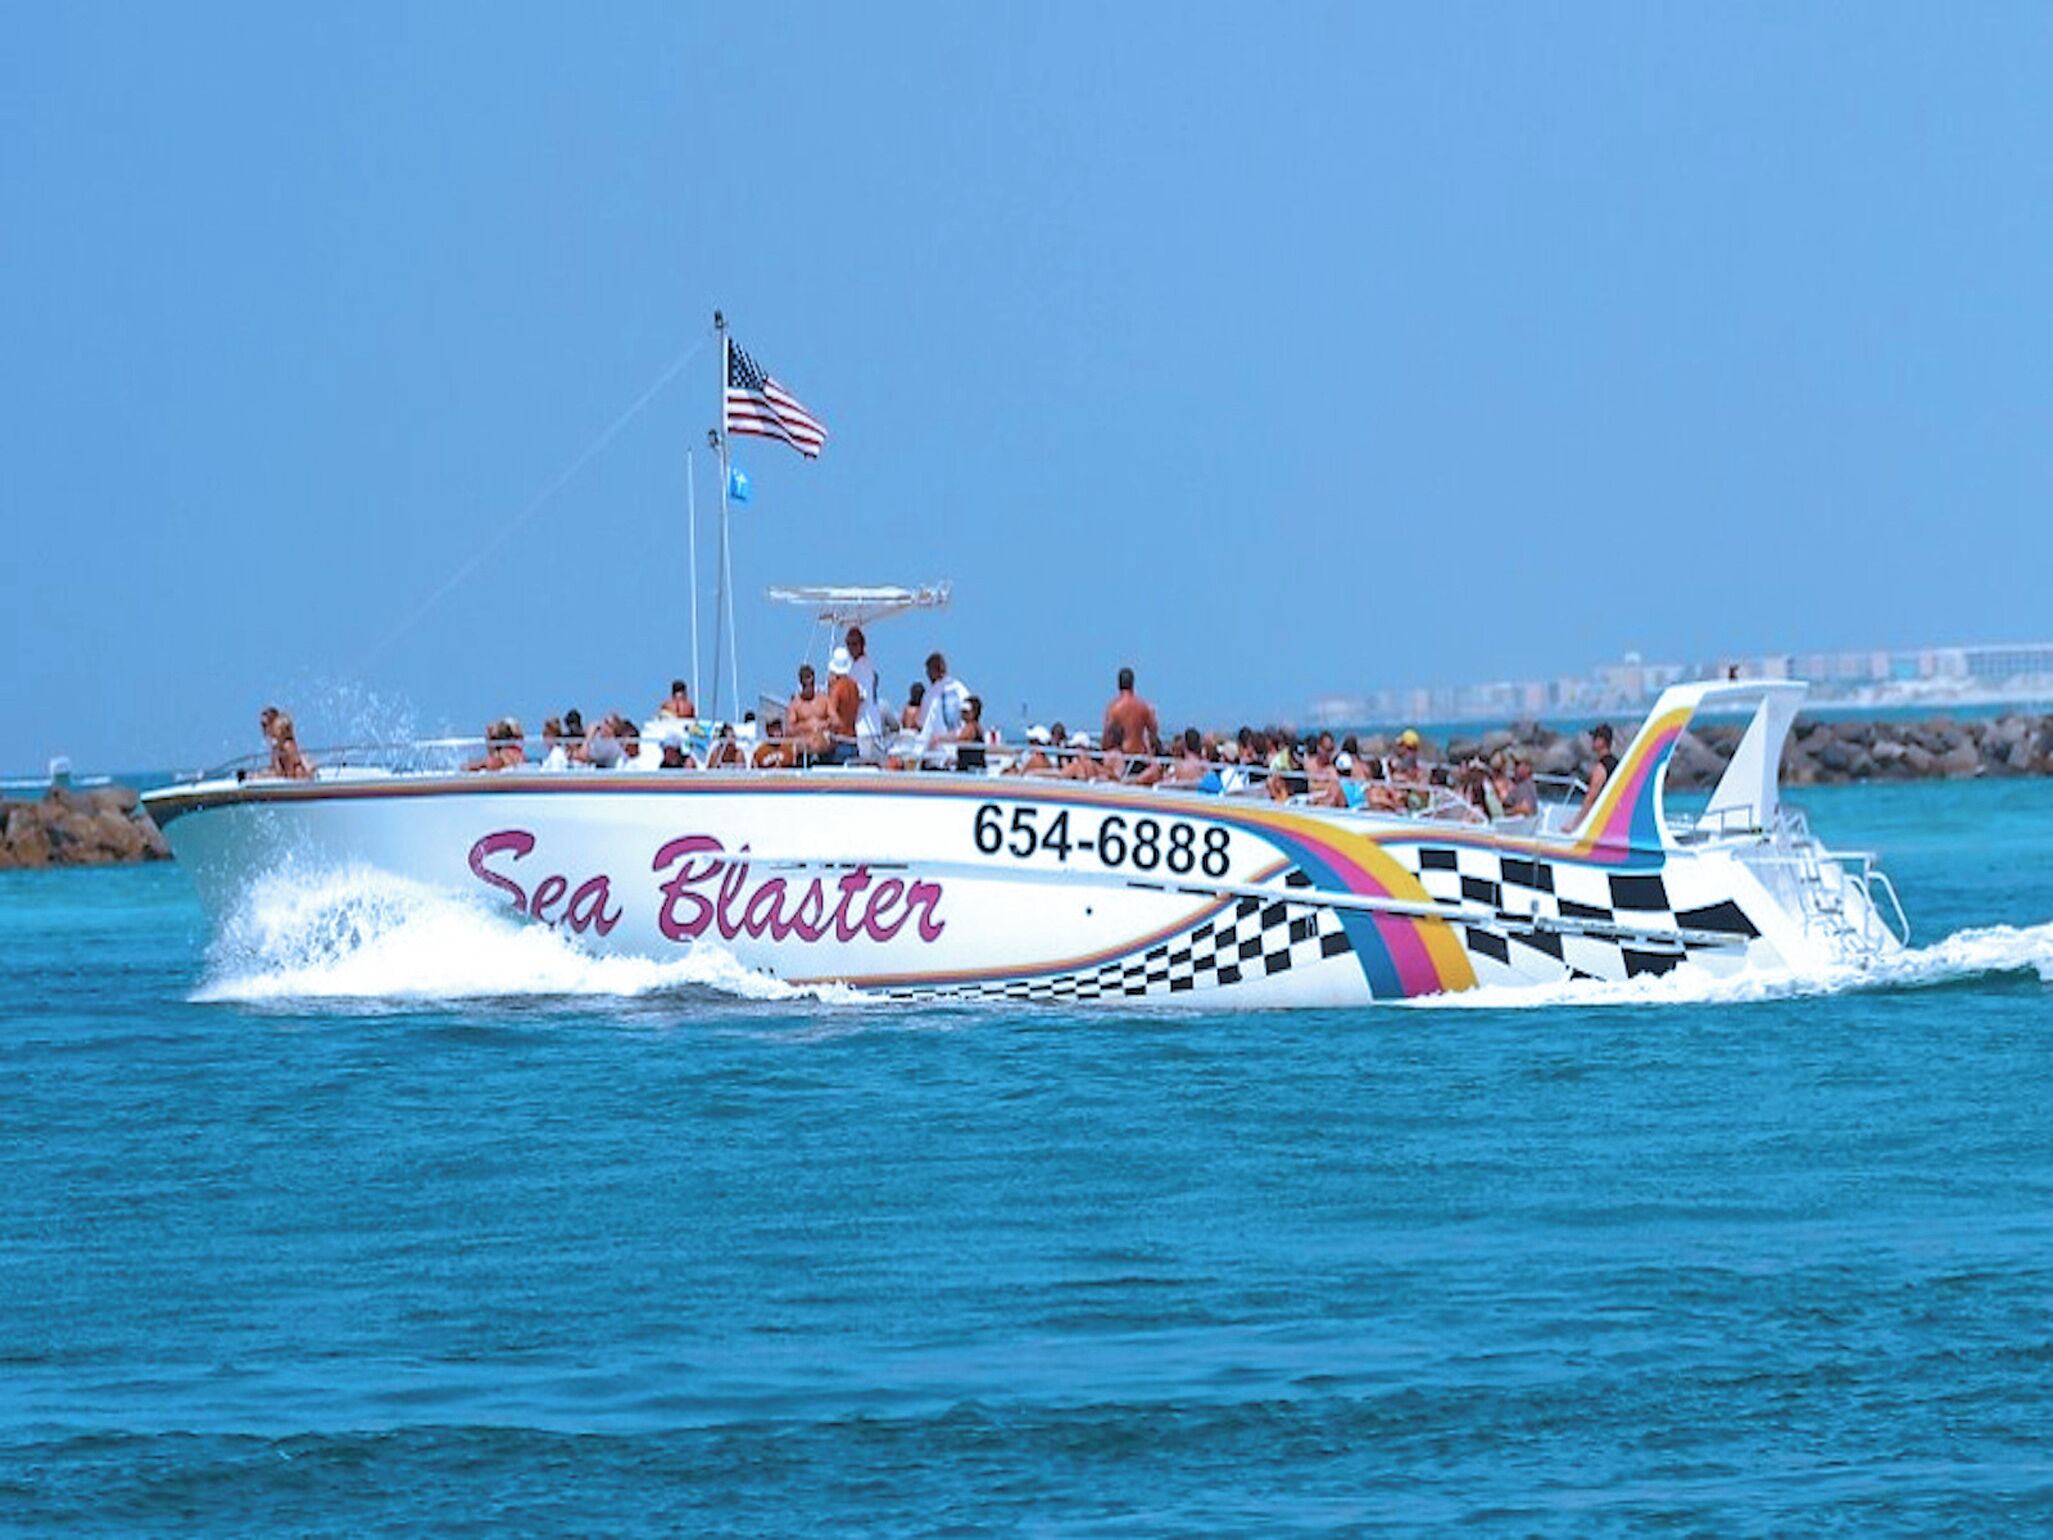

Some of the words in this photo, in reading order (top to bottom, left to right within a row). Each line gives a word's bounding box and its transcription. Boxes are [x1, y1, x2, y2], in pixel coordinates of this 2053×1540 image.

[468, 829, 622, 935] Sea
[652, 834, 945, 942] Blaster
[973, 803, 1230, 877] 654-6888
